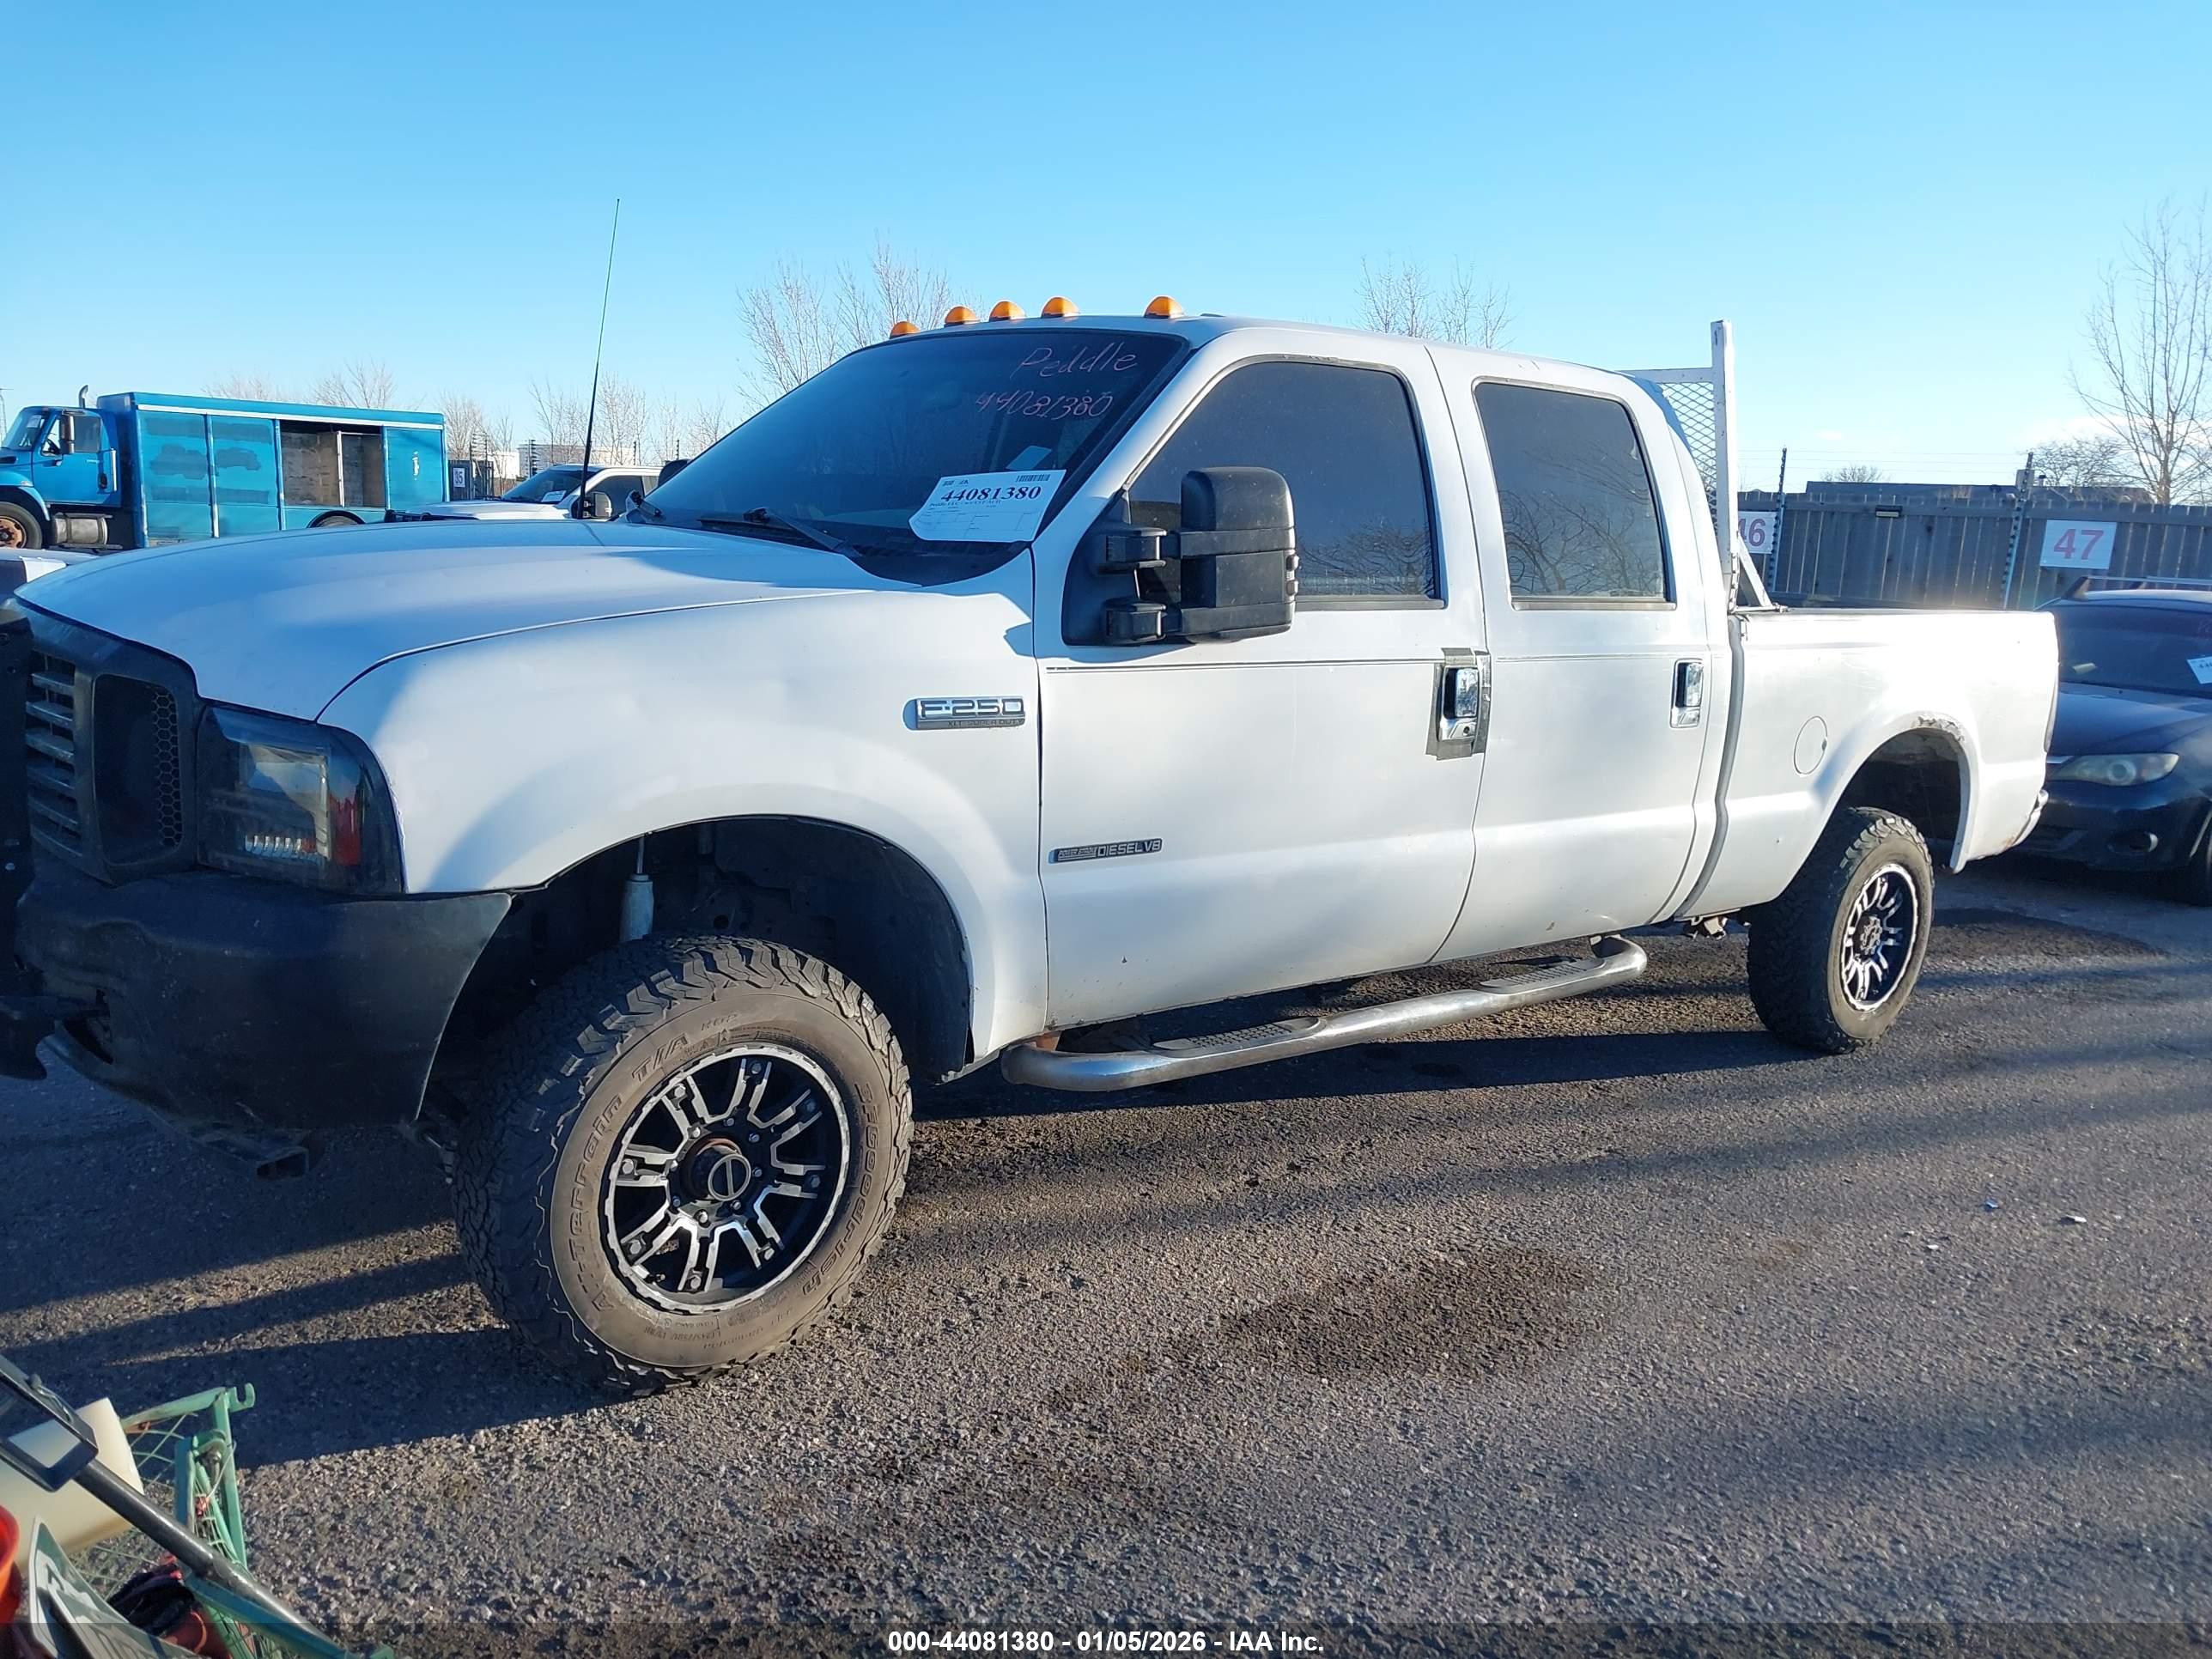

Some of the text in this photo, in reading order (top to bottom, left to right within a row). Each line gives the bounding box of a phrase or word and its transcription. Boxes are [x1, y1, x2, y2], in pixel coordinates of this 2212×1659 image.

[1010, 342, 1138, 380] Peddle
[975, 391, 1113, 420] 44081380
[941, 486, 1042, 502] 44081380
[2053, 529, 2104, 560] 47
[1097, 842, 1142, 857] DIESEL
[1144, 840, 1161, 852] V8
